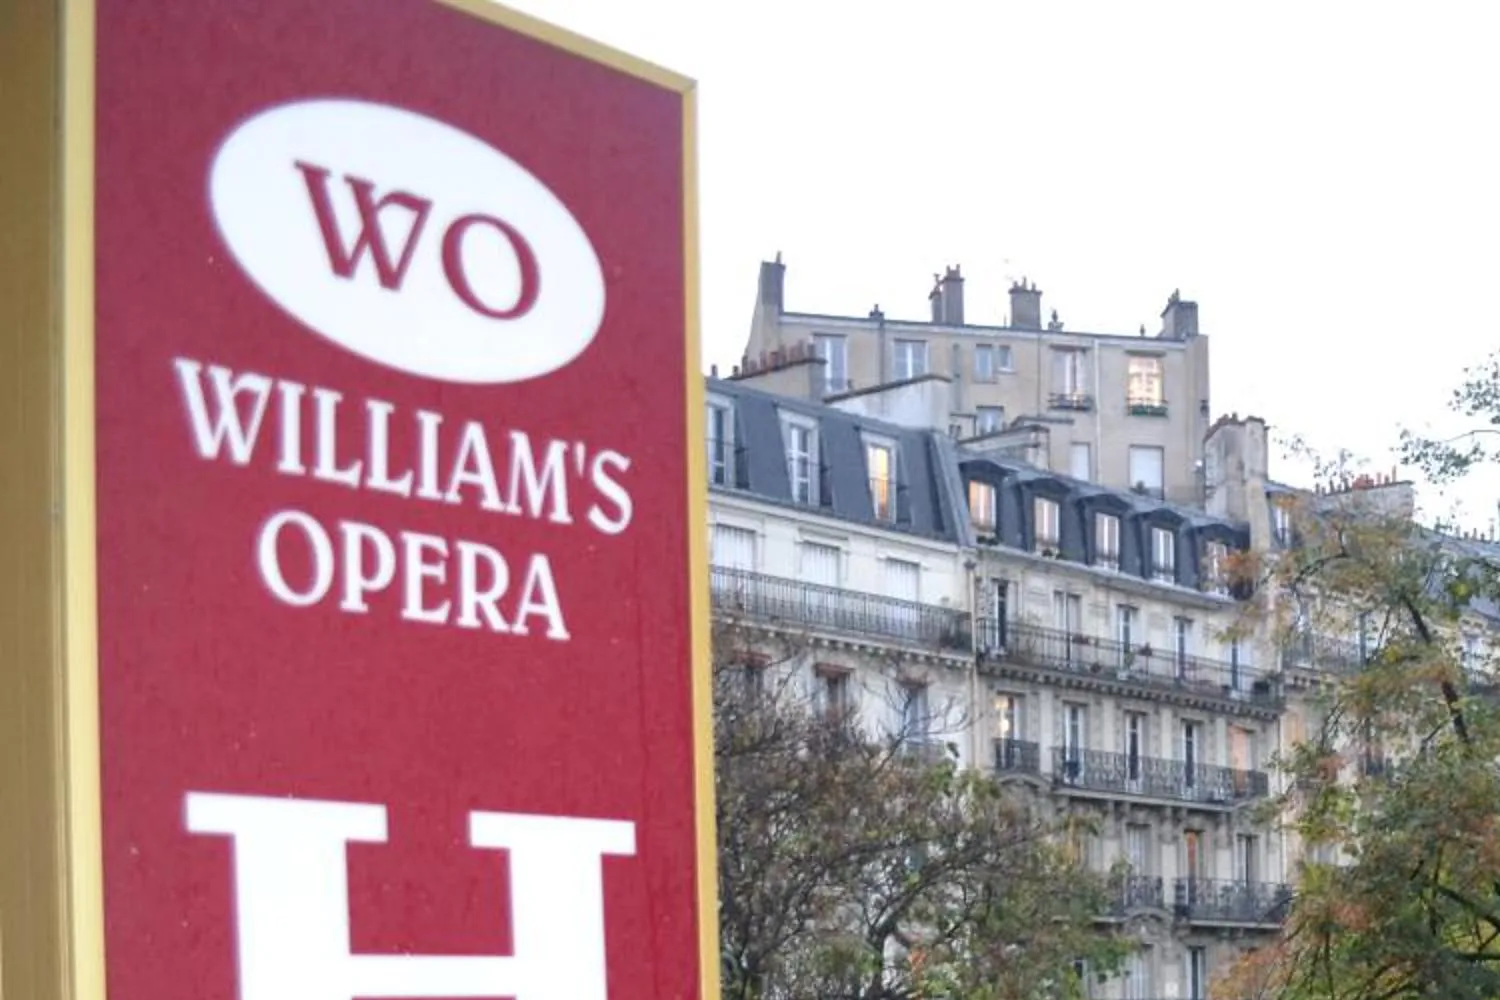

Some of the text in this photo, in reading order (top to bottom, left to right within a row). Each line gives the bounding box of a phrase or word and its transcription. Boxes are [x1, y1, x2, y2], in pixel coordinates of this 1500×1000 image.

[294, 160, 541, 321] WO
[174, 357, 634, 536] WILLIAM'S
[257, 509, 571, 642] OPERA
